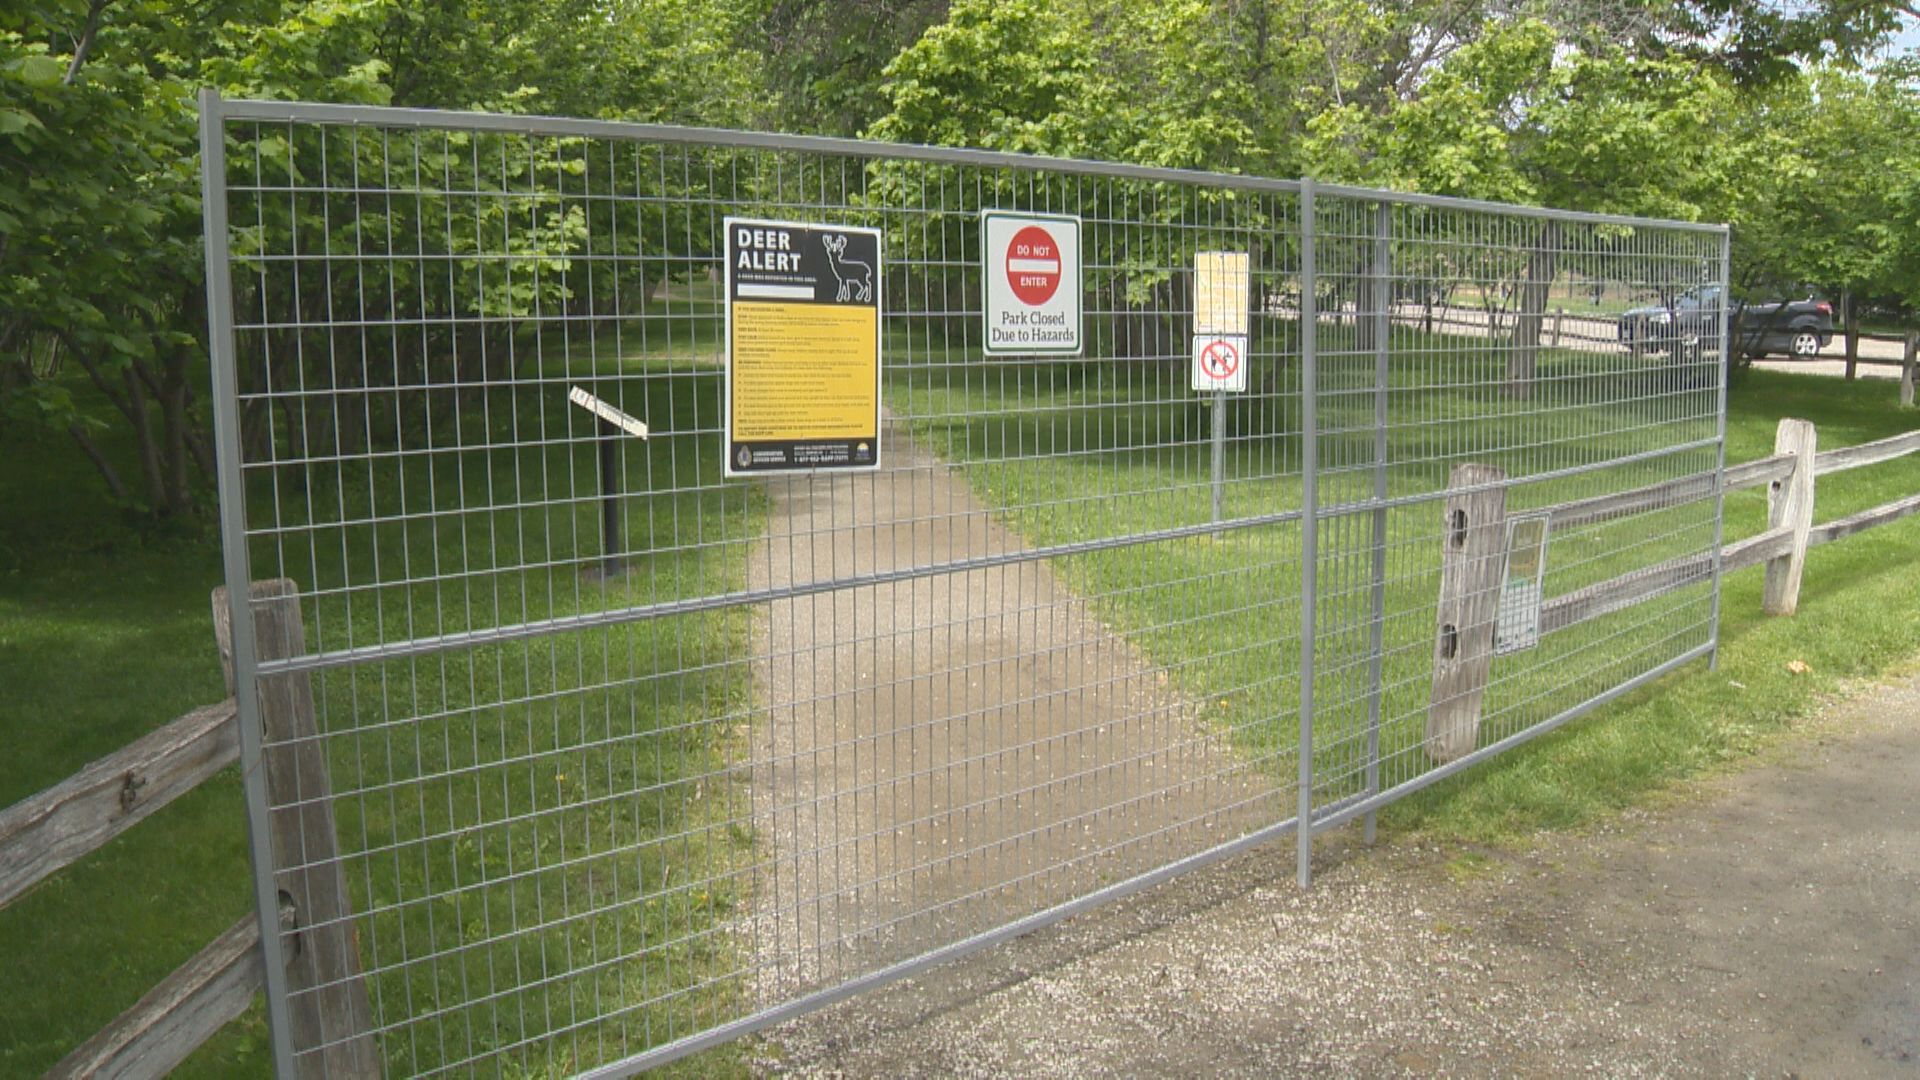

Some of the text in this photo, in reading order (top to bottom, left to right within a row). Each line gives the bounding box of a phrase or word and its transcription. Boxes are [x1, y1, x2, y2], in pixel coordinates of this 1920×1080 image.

[738, 229, 790, 250] DEER
[1017, 245, 1050, 256] DO NOT
[738, 251, 801, 272] ALERT
[1020, 276, 1047, 288] ENTER
[1002, 311, 1065, 326] Park Closed
[992, 328, 1074, 343] Due to Hazards
